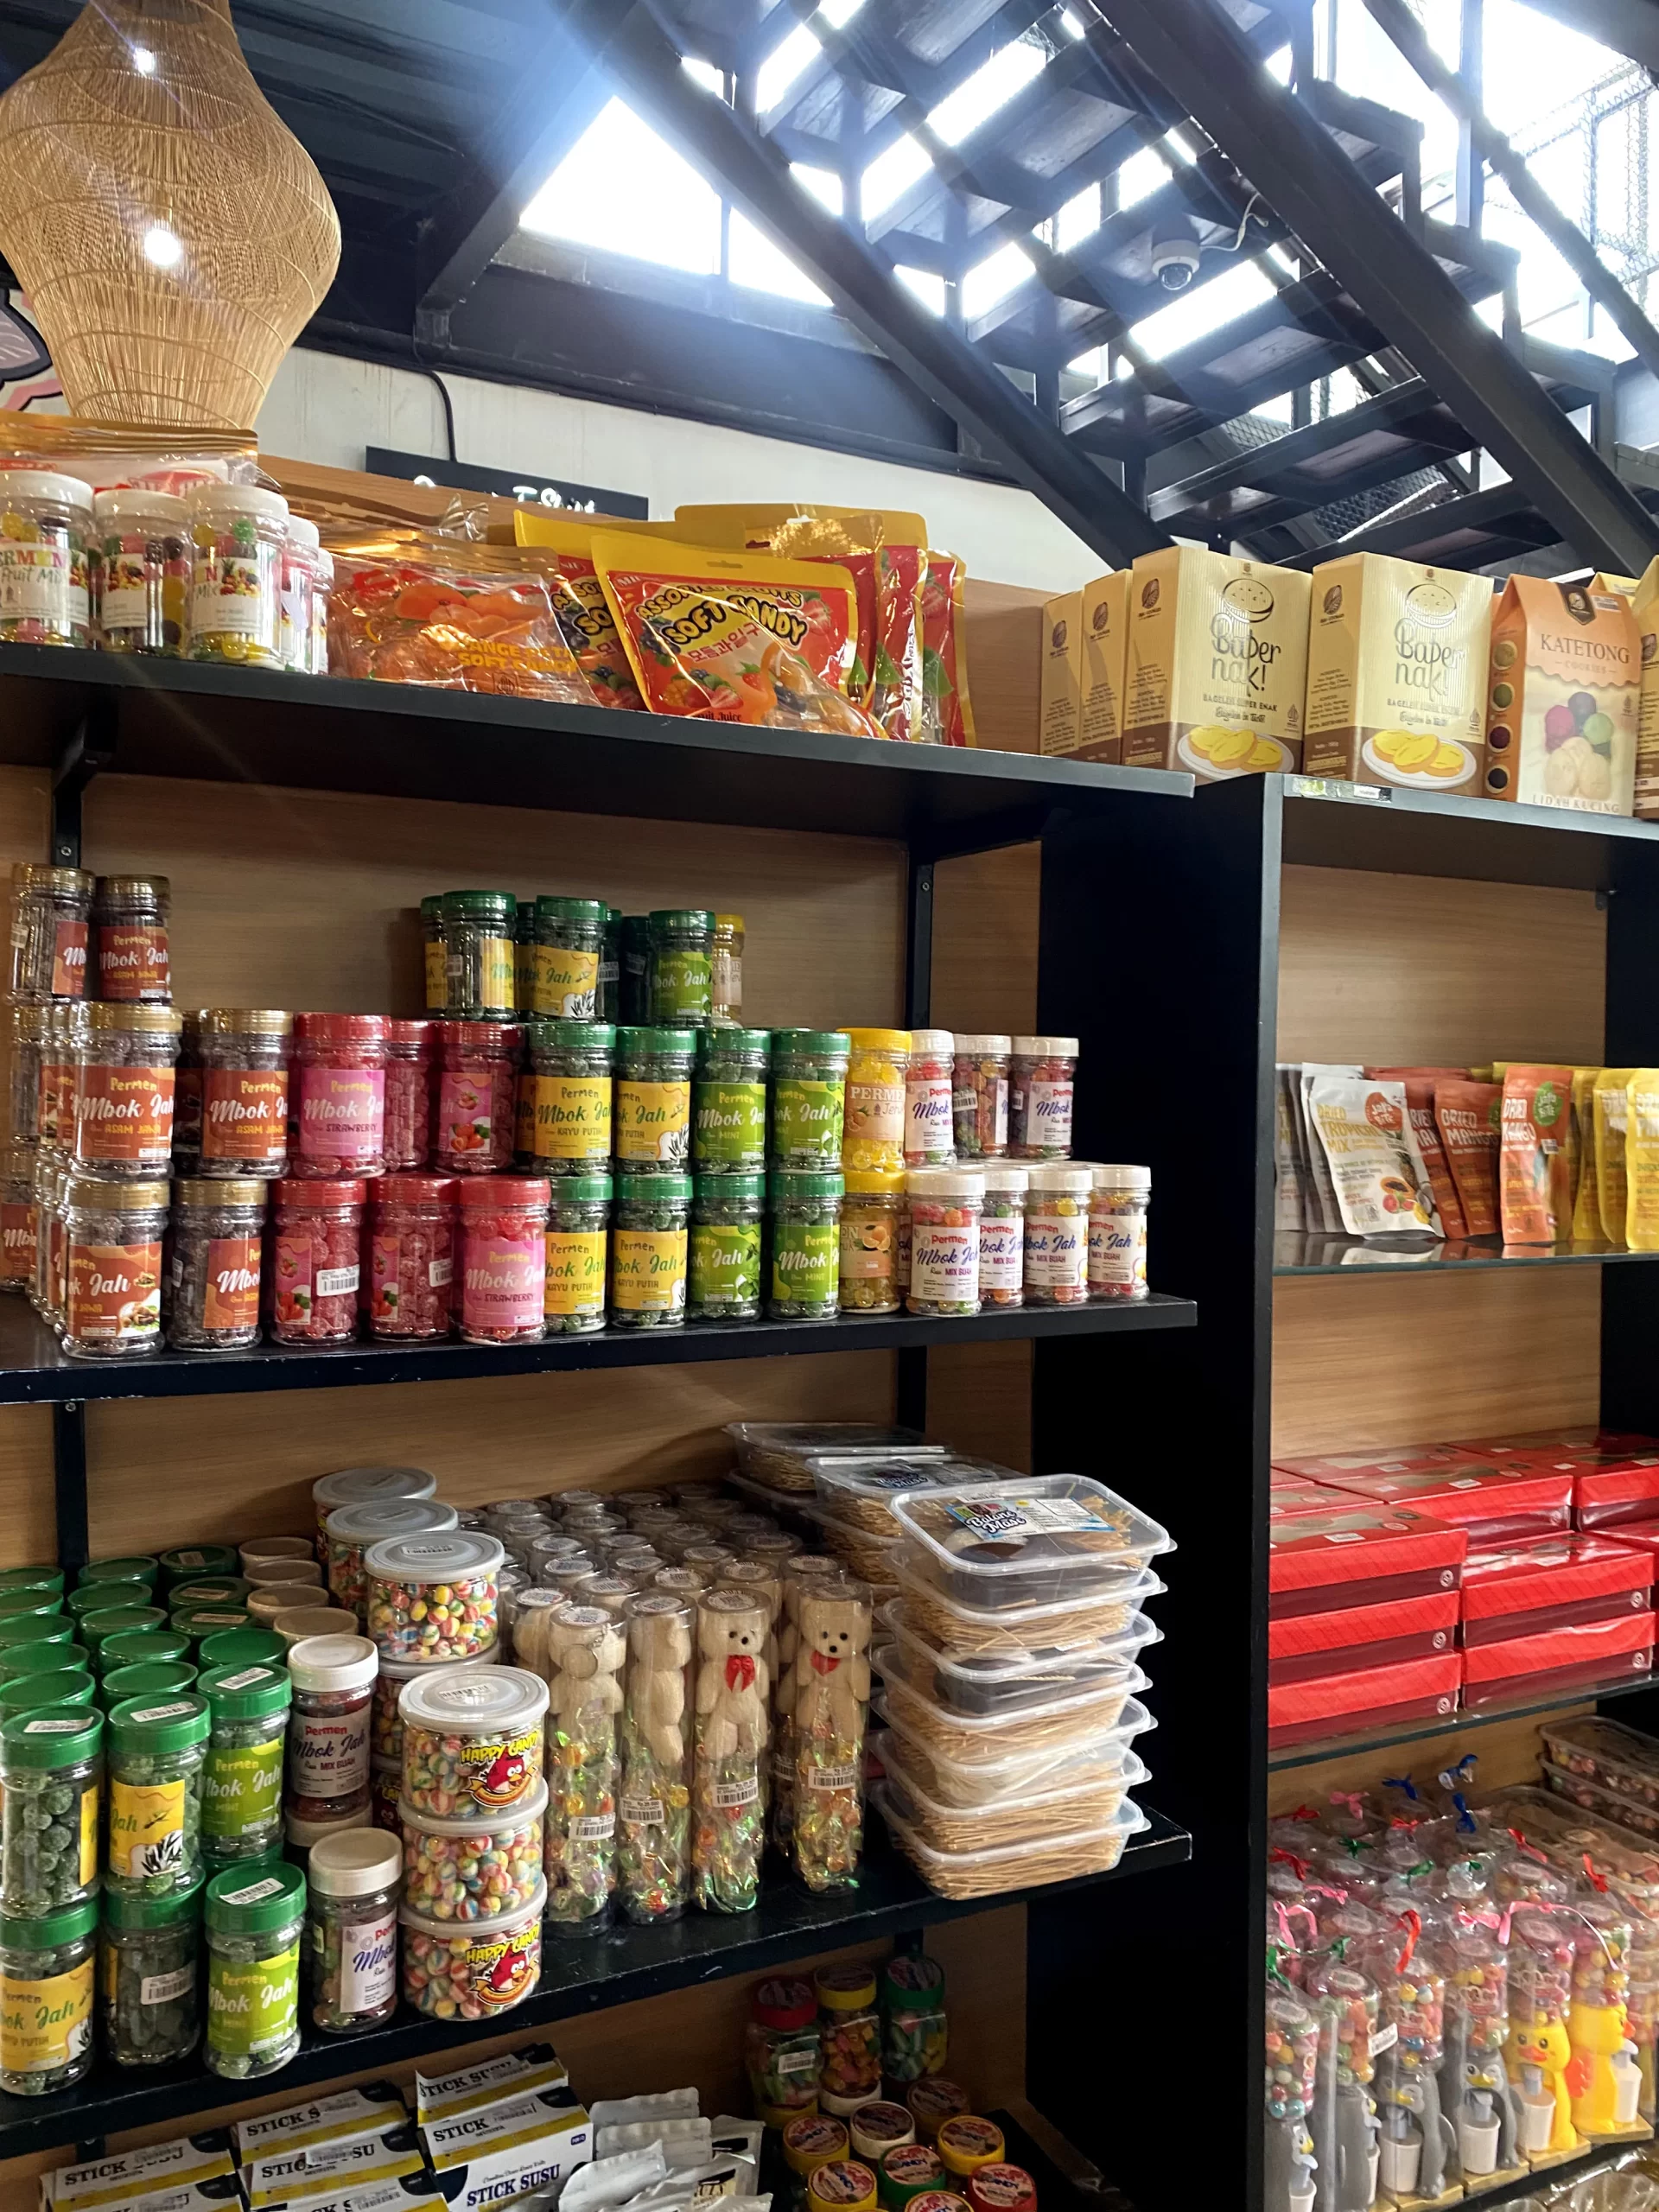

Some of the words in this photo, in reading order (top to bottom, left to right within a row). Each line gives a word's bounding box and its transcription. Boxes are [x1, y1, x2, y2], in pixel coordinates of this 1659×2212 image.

[661, 601, 727, 645] SOFT
[727, 594, 809, 646] CANDY
[1540, 633, 1630, 664] KATETONG
[546, 967, 572, 985] Jah
[683, 969, 707, 988] Jah
[110, 1077, 157, 1092] Permen
[240, 1080, 282, 1095] Permen
[562, 1086, 600, 1100] Permen
[850, 1086, 905, 1102] PERME
[718, 1091, 755, 1104] Permen
[84, 1096, 141, 1122] Mbok
[210, 1099, 271, 1122] Mbok
[276, 1096, 288, 1117] Ja
[304, 1097, 358, 1121] Mbok
[537, 1105, 588, 1125] Mbok
[635, 1104, 667, 1124] Jah
[696, 1109, 742, 1128] Mbok
[800, 1103, 831, 1122] Jah
[912, 1102, 950, 1120] Mbok
[1036, 1102, 1070, 1117] Mbok
[1316, 1103, 1347, 1121] DRIED
[1440, 1108, 1478, 1129] DRIED
[1325, 1138, 1352, 1154] MIX
[980, 1224, 1014, 1236] Permen
[1027, 1221, 1059, 1234] Permen
[1089, 1220, 1115, 1232] ermen
[550, 1242, 590, 1255] Permen
[620, 1239, 655, 1252] Permen
[931, 1234, 969, 1245] Permen
[1053, 1233, 1077, 1250] Jah
[1107, 1230, 1132, 1249] Jah
[488, 1251, 531, 1263] Permen
[649, 1254, 677, 1274] Jah
[711, 1249, 747, 1268] Jah
[779, 1250, 828, 1272] Mbok
[916, 1247, 959, 1266] Mbok
[467, 1268, 518, 1289] Mbok
[546, 1262, 575, 1278] bok
[88, 1273, 131, 1297] Jah
[305, 1725, 348, 1736] Permen
[292, 1737, 335, 1758] Mbok
[340, 1728, 365, 1757] Jah
[460, 1745, 507, 1767] HAPPY
[508, 1731, 539, 1756] CANDY
[216, 1758, 259, 1772] Permen
[320, 1759, 336, 1770] MIX
[336, 1758, 356, 1769] BUAH
[251, 1762, 282, 1791] Jah
[465, 1947, 509, 1967] HAPPY
[511, 1924, 540, 1950] CANDY
[222, 1972, 268, 1986] Permen
[260, 1977, 294, 2010] Jah
[35, 1999, 74, 2030] Jah
[418, 2075, 467, 2099] STICK
[246, 2114, 302, 2139] STICK
[433, 2117, 491, 2144] STICK
[64, 2160, 126, 2186] STICK
[261, 2154, 321, 2178] STIC
[467, 2178, 518, 2207] STICK
[520, 2164, 561, 2191] SUSU
